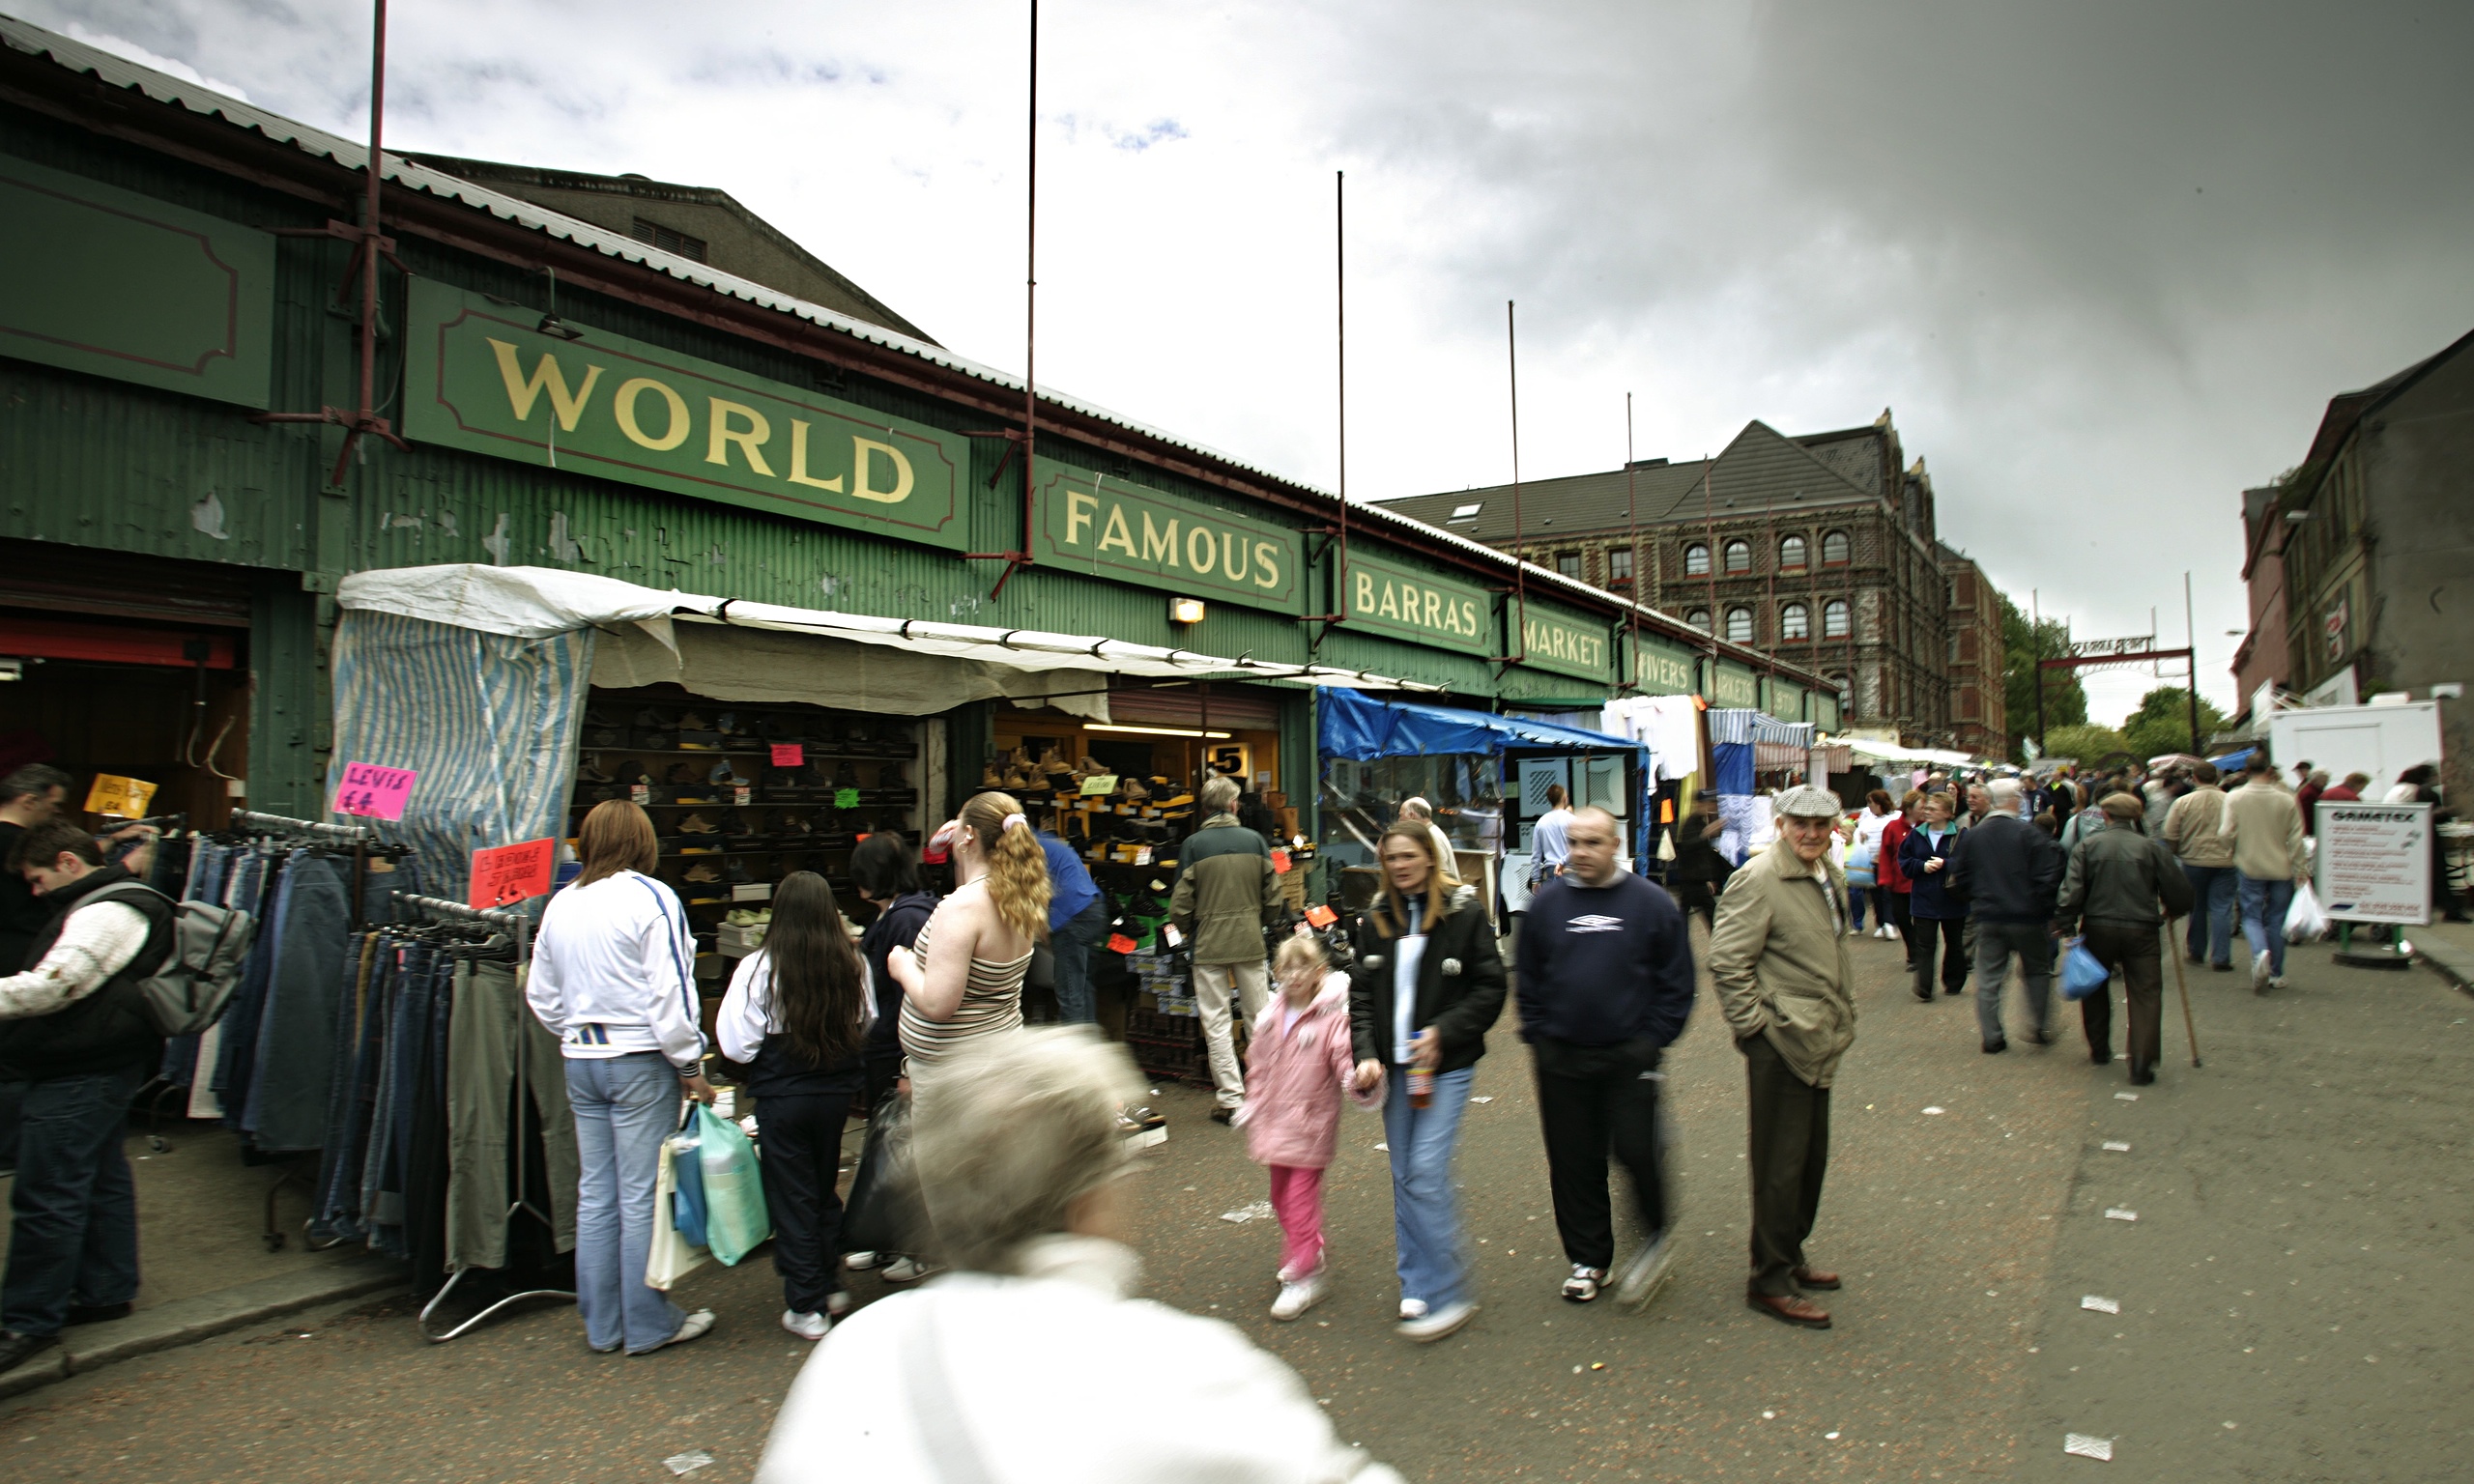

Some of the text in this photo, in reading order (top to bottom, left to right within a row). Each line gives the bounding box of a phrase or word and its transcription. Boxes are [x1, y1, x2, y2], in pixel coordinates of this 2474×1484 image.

[485, 336, 915, 504] WORLD
[1064, 490, 1280, 589] FAMOUS
[1355, 571, 1478, 638] BARRAS
[1523, 617, 1603, 668] MARKET
[347, 767, 409, 790] LEVIS
[1215, 747, 1242, 774] 5
[343, 790, 374, 812] £4
[2331, 812, 2417, 823] GAMETEX
